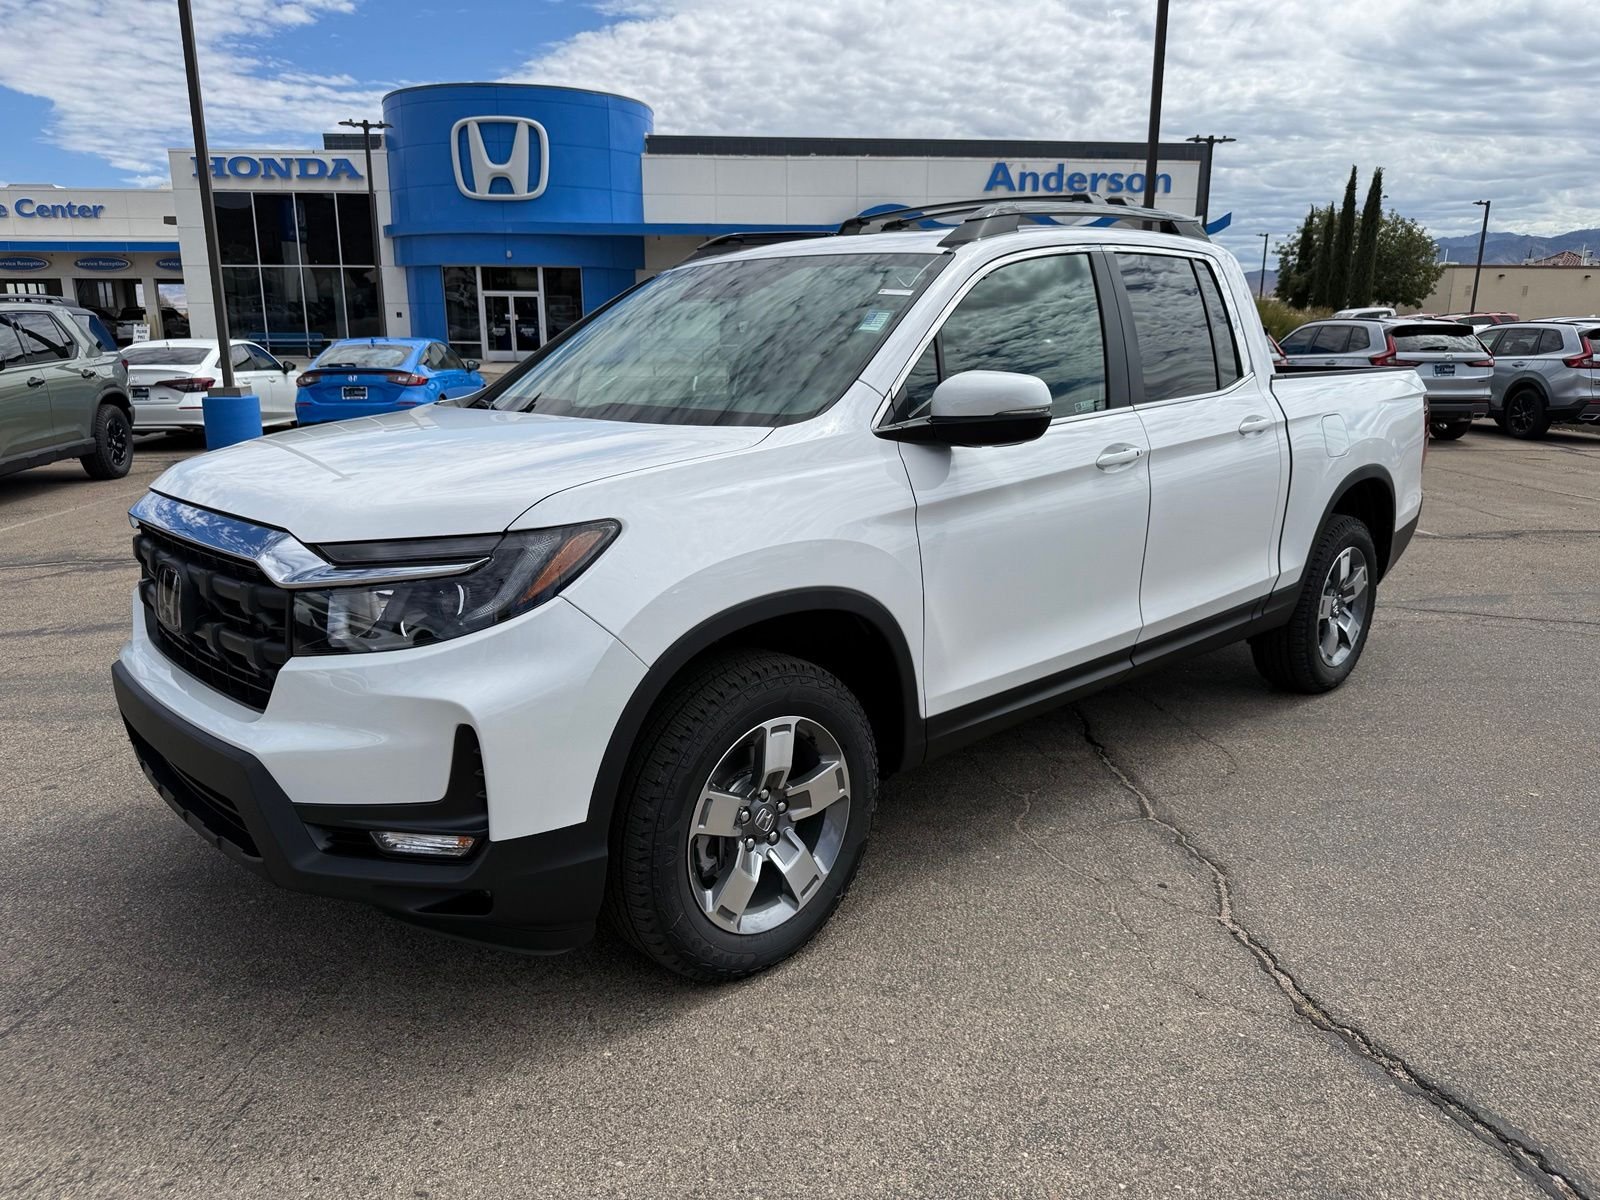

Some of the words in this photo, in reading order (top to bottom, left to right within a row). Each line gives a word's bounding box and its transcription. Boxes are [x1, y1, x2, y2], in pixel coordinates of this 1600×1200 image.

[190, 156, 364, 179] HONDA
[983, 162, 1172, 193] Anderson
[15, 198, 104, 218] Center
